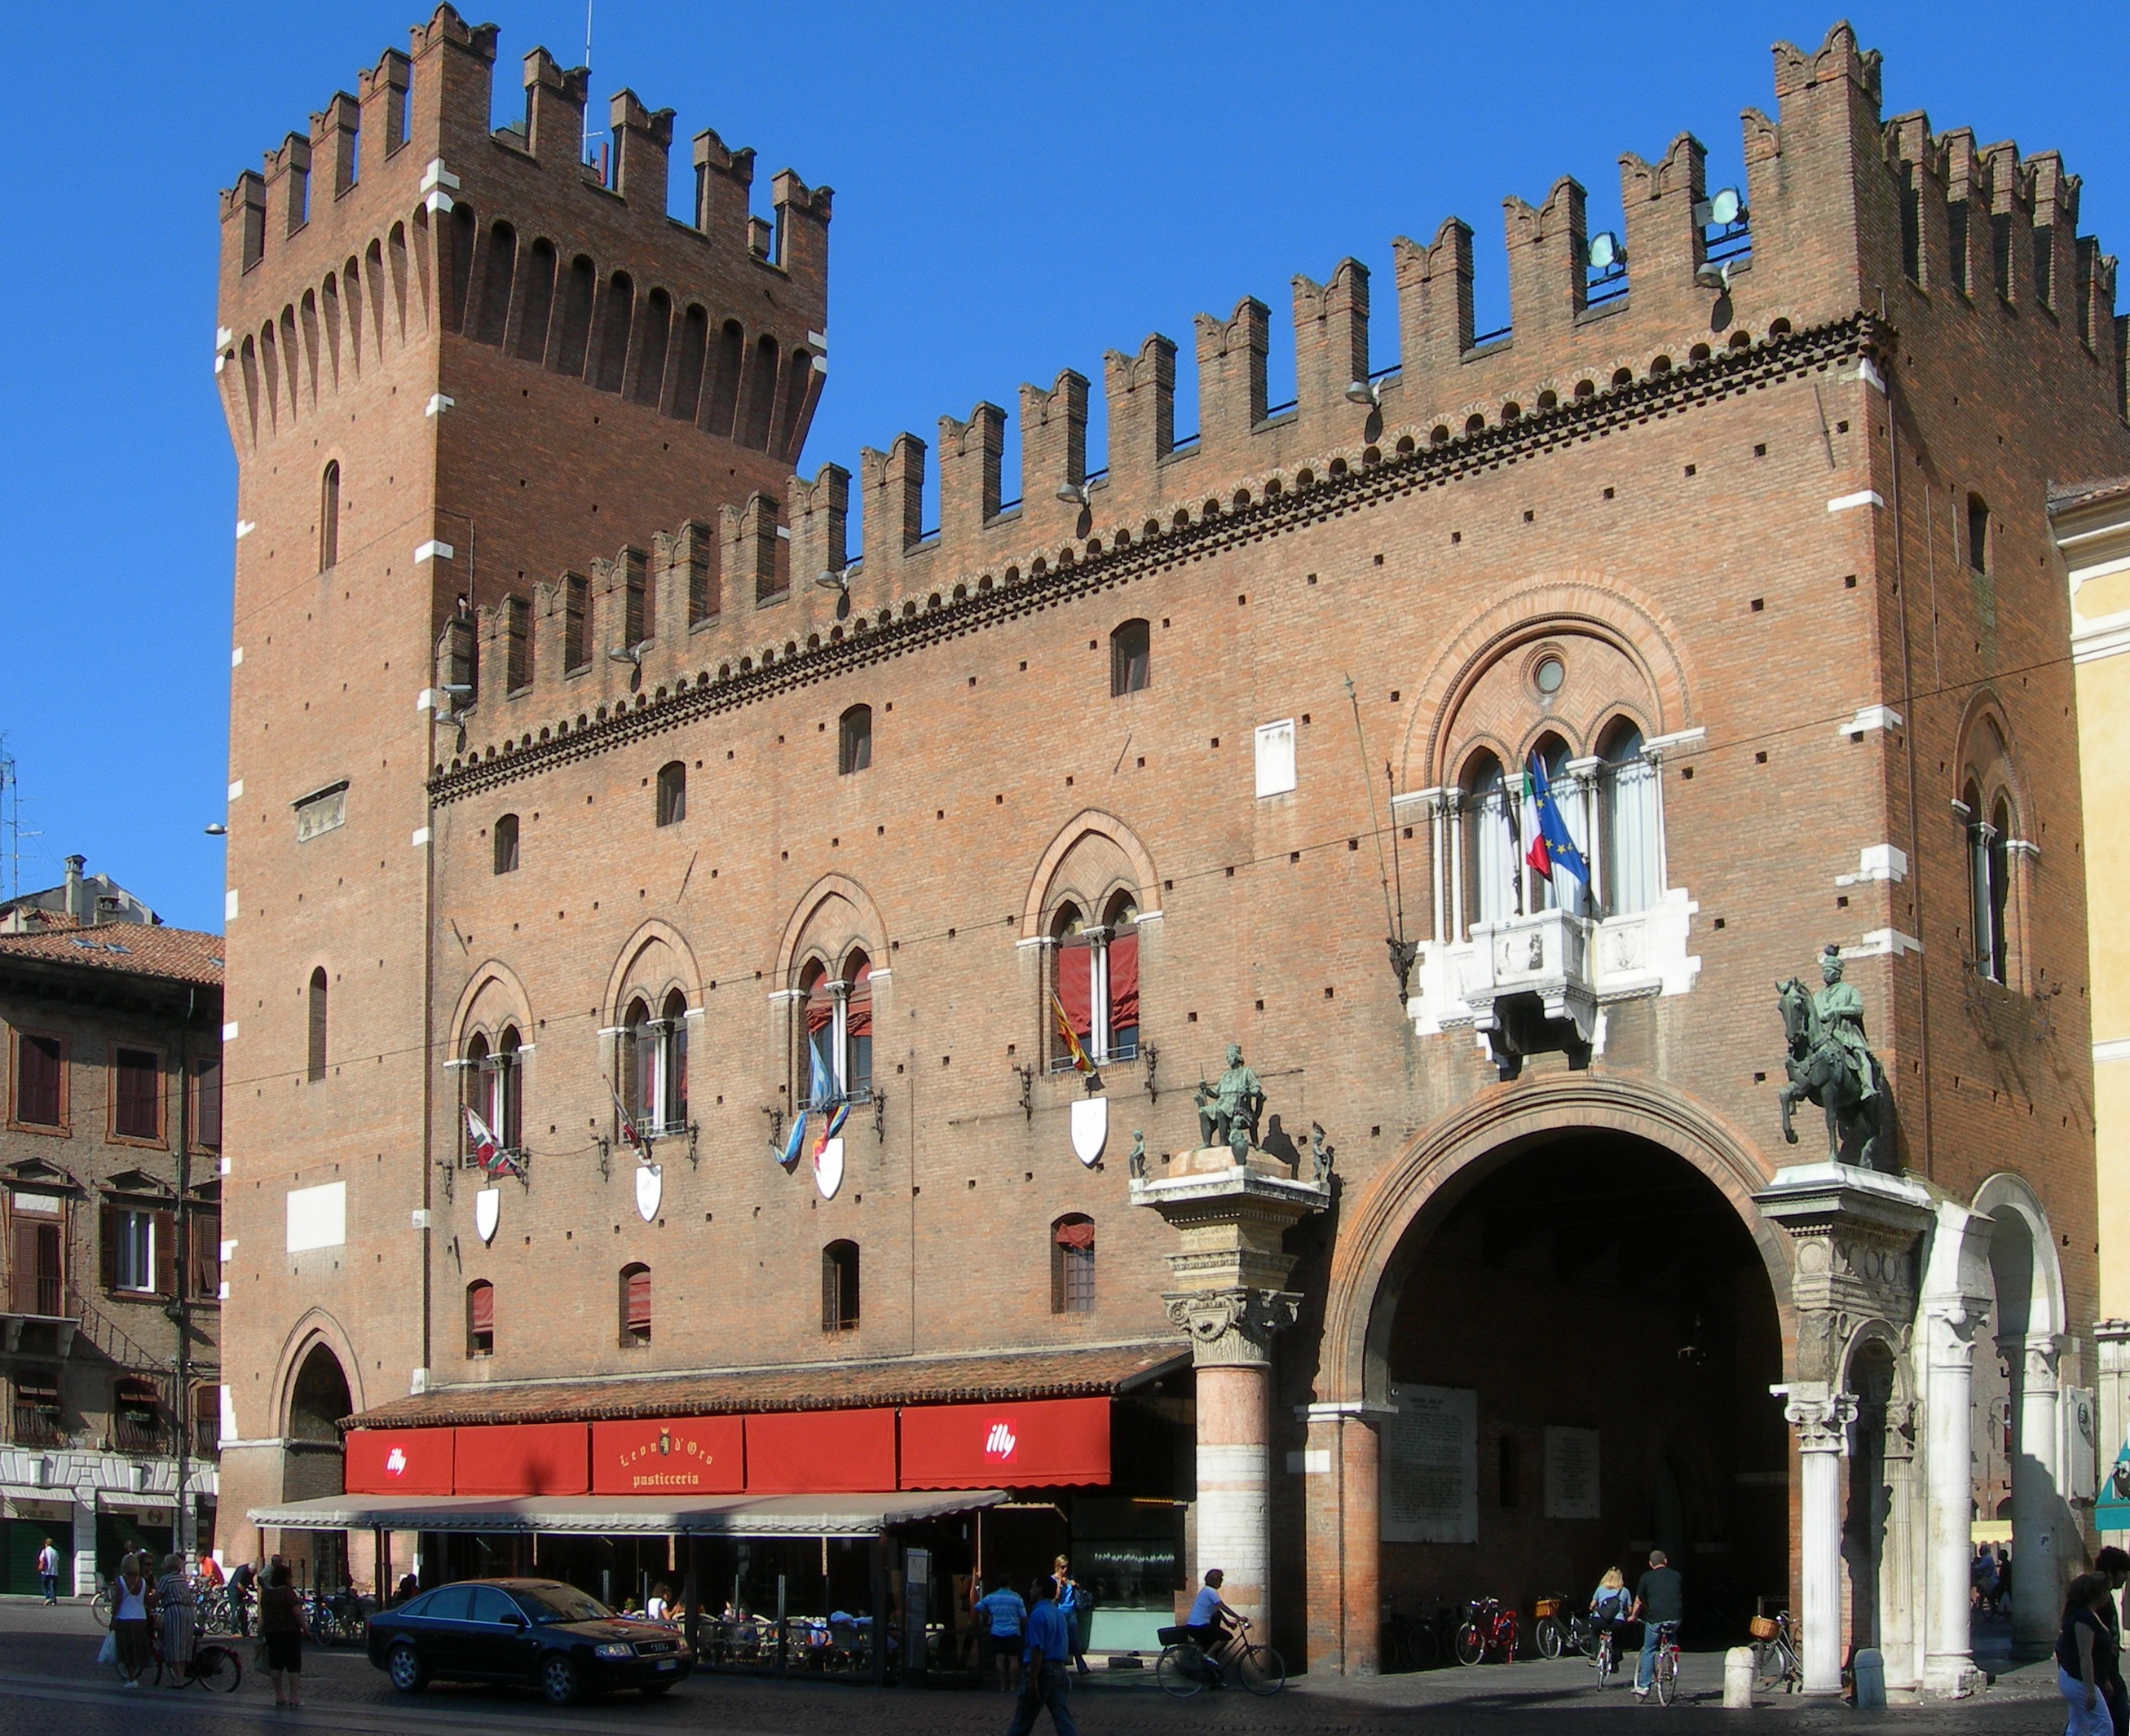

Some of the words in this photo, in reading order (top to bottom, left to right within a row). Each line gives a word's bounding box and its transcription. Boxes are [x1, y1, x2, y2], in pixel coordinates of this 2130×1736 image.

[620, 1443, 657, 1467] Leon
[675, 1438, 714, 1465] d'Oro
[986, 1423, 1016, 1460] illy
[387, 1447, 407, 1476] illy
[633, 1472, 699, 1488] pasticceria
